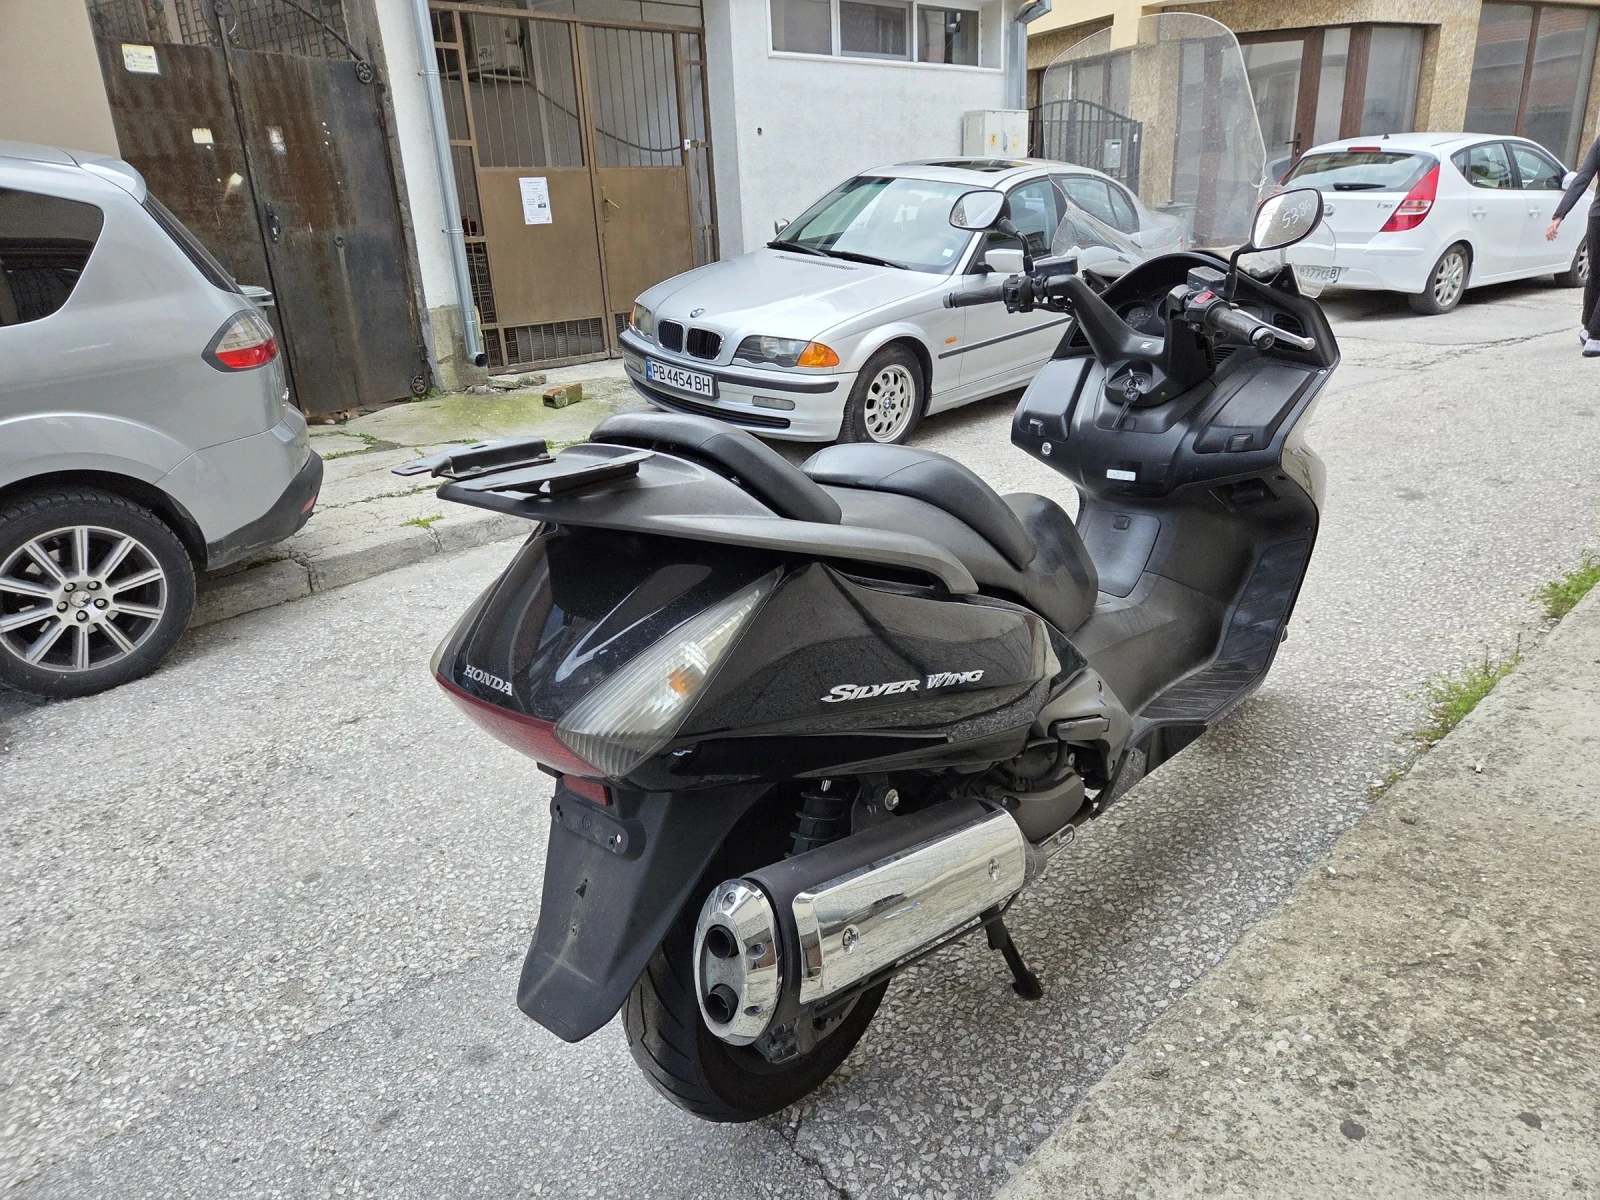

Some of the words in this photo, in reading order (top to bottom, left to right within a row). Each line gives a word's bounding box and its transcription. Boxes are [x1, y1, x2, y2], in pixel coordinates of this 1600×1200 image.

[1282, 200, 1312, 229] 5386
[463, 664, 513, 697] HONDA
[820, 679, 921, 703] SILVER
[926, 669, 985, 690] WING
